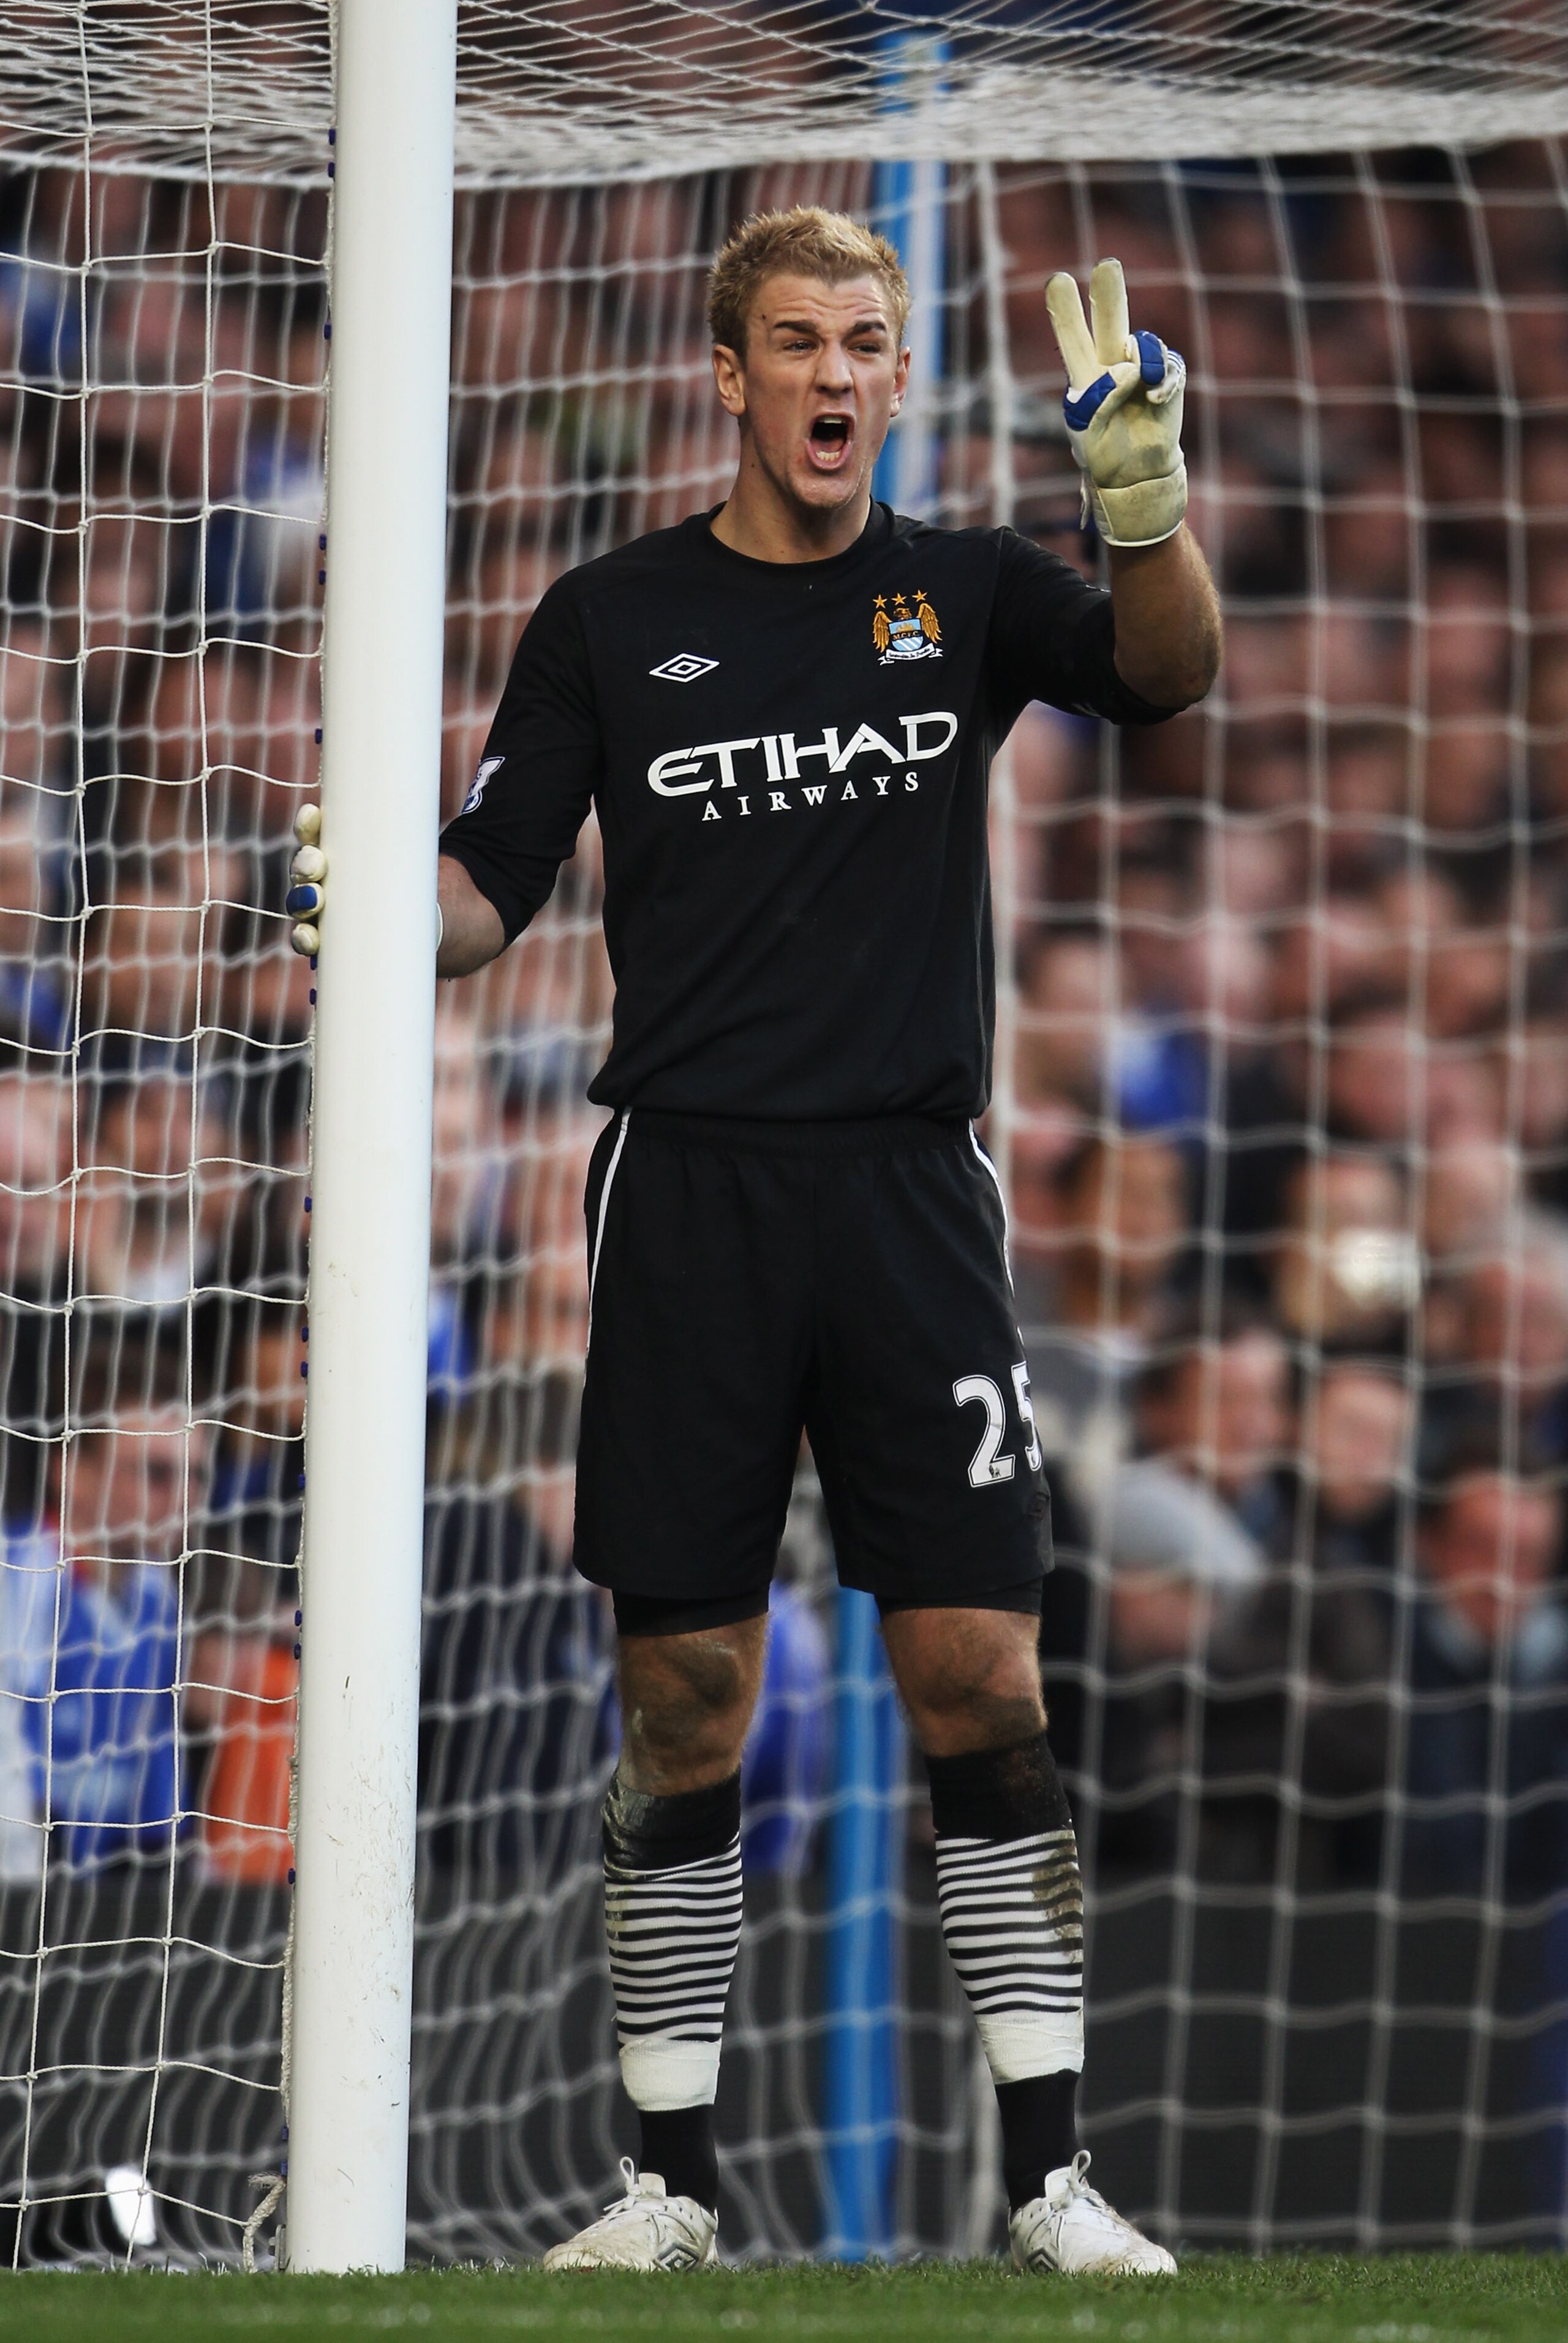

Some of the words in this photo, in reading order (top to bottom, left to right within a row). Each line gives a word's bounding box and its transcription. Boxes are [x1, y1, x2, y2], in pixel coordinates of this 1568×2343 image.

[647, 711, 958, 797] ETIHAD
[702, 772, 919, 821] AIRWAYS
[952, 1360, 1042, 1487] 25
